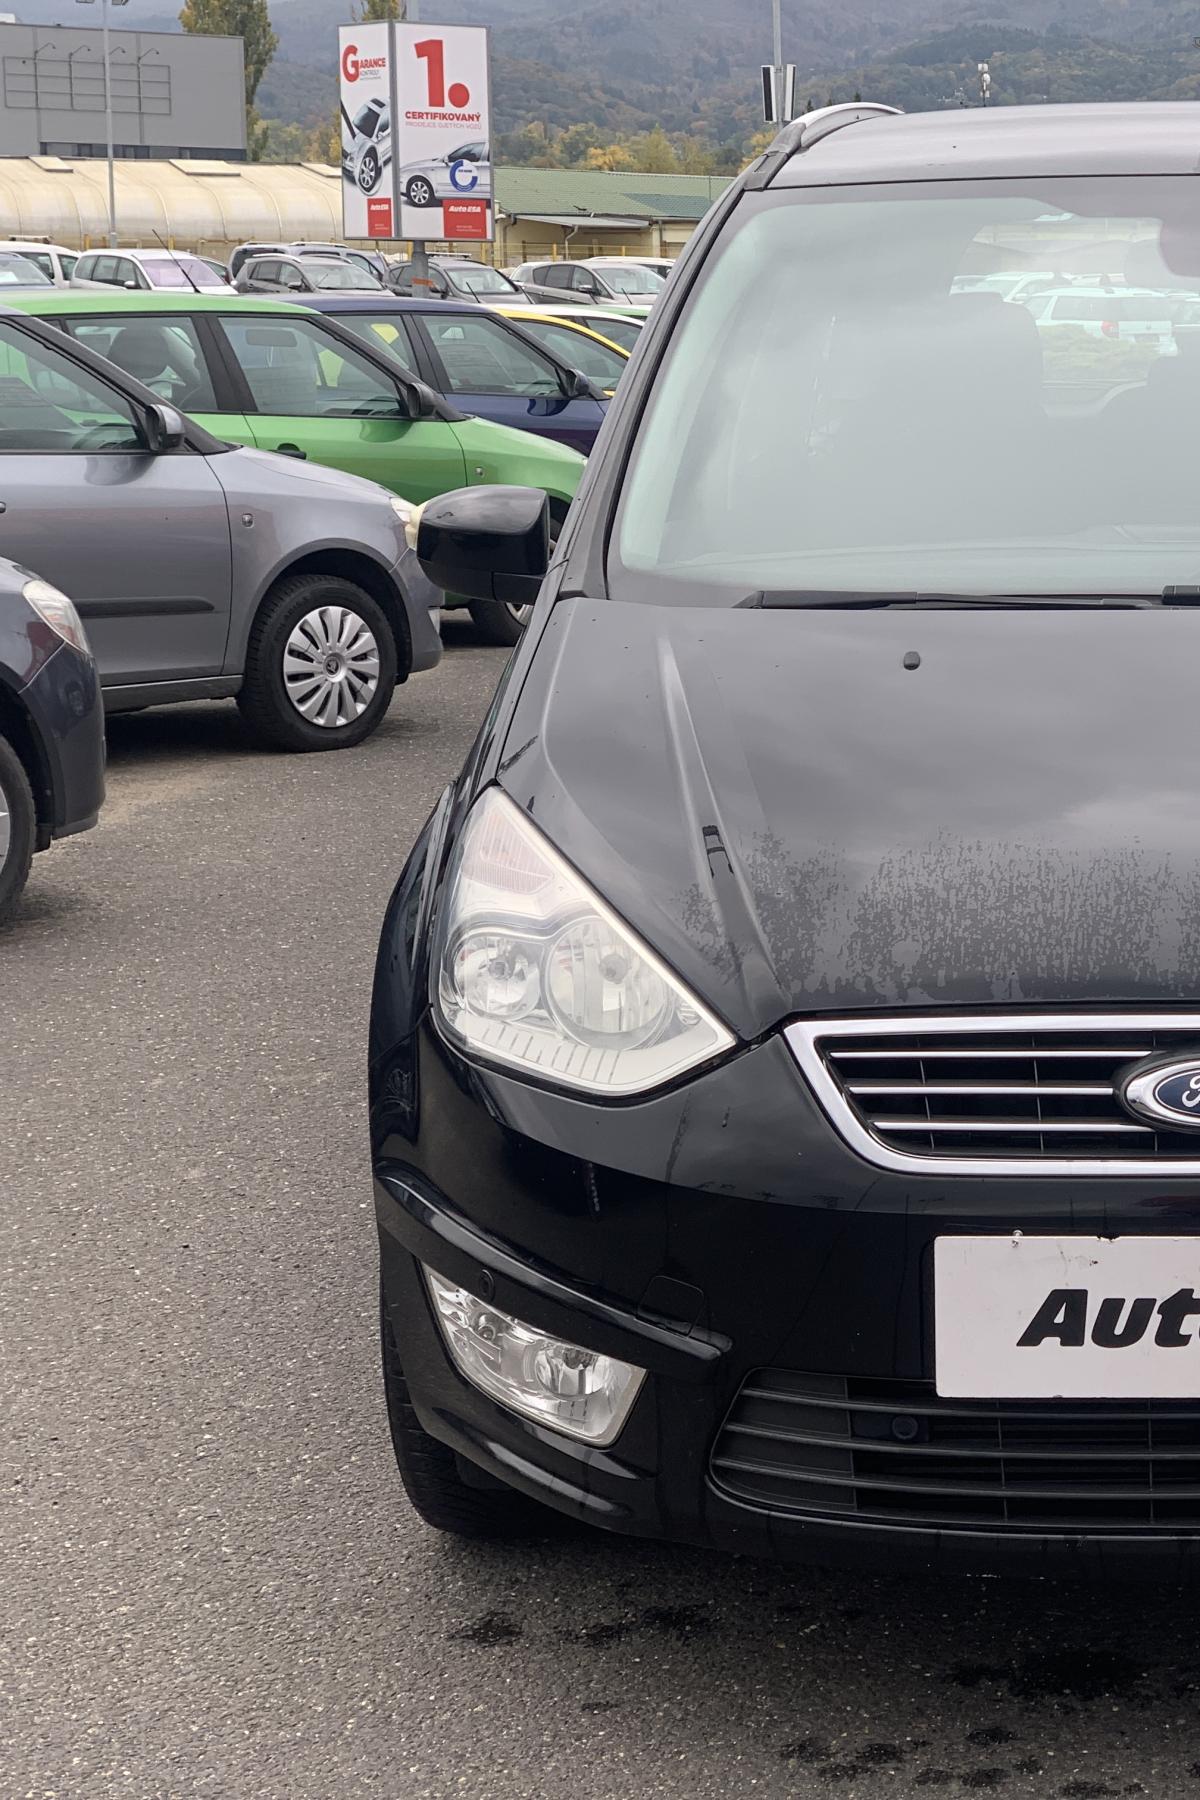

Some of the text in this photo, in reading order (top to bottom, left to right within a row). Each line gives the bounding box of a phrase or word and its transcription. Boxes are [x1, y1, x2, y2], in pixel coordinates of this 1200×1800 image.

[342, 44, 386, 83] GARANCE
[414, 39, 470, 108] 1.
[405, 111, 481, 122] CERTIFIKOVANÝ
